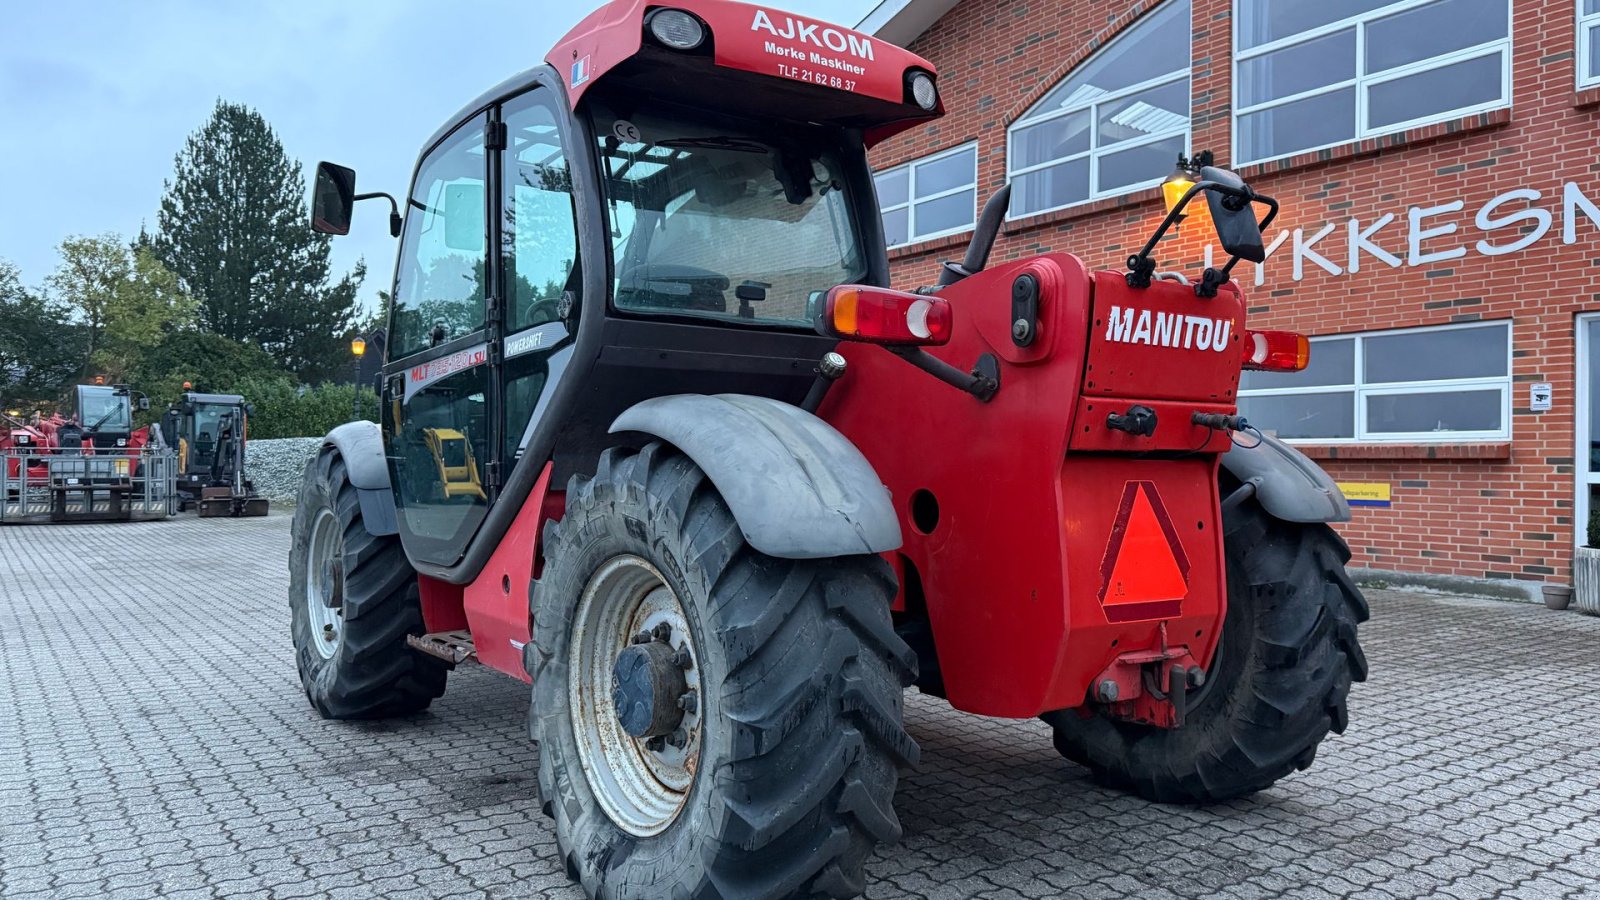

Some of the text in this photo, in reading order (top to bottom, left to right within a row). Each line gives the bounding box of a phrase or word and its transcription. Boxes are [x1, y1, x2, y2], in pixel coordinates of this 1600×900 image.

[751, 9, 875, 61] AJKOM
[764, 41, 866, 76] Mørke Maskiner
[801, 69, 812, 82] 21
[815, 72, 827, 86] 62
[830, 76, 842, 89] 68
[844, 80, 856, 92] 37
[506, 331, 543, 356] POWERSHIFT
[1105, 305, 1231, 353] MANITOU
[411, 364, 430, 382] MLT
[469, 350, 486, 366] LSU
